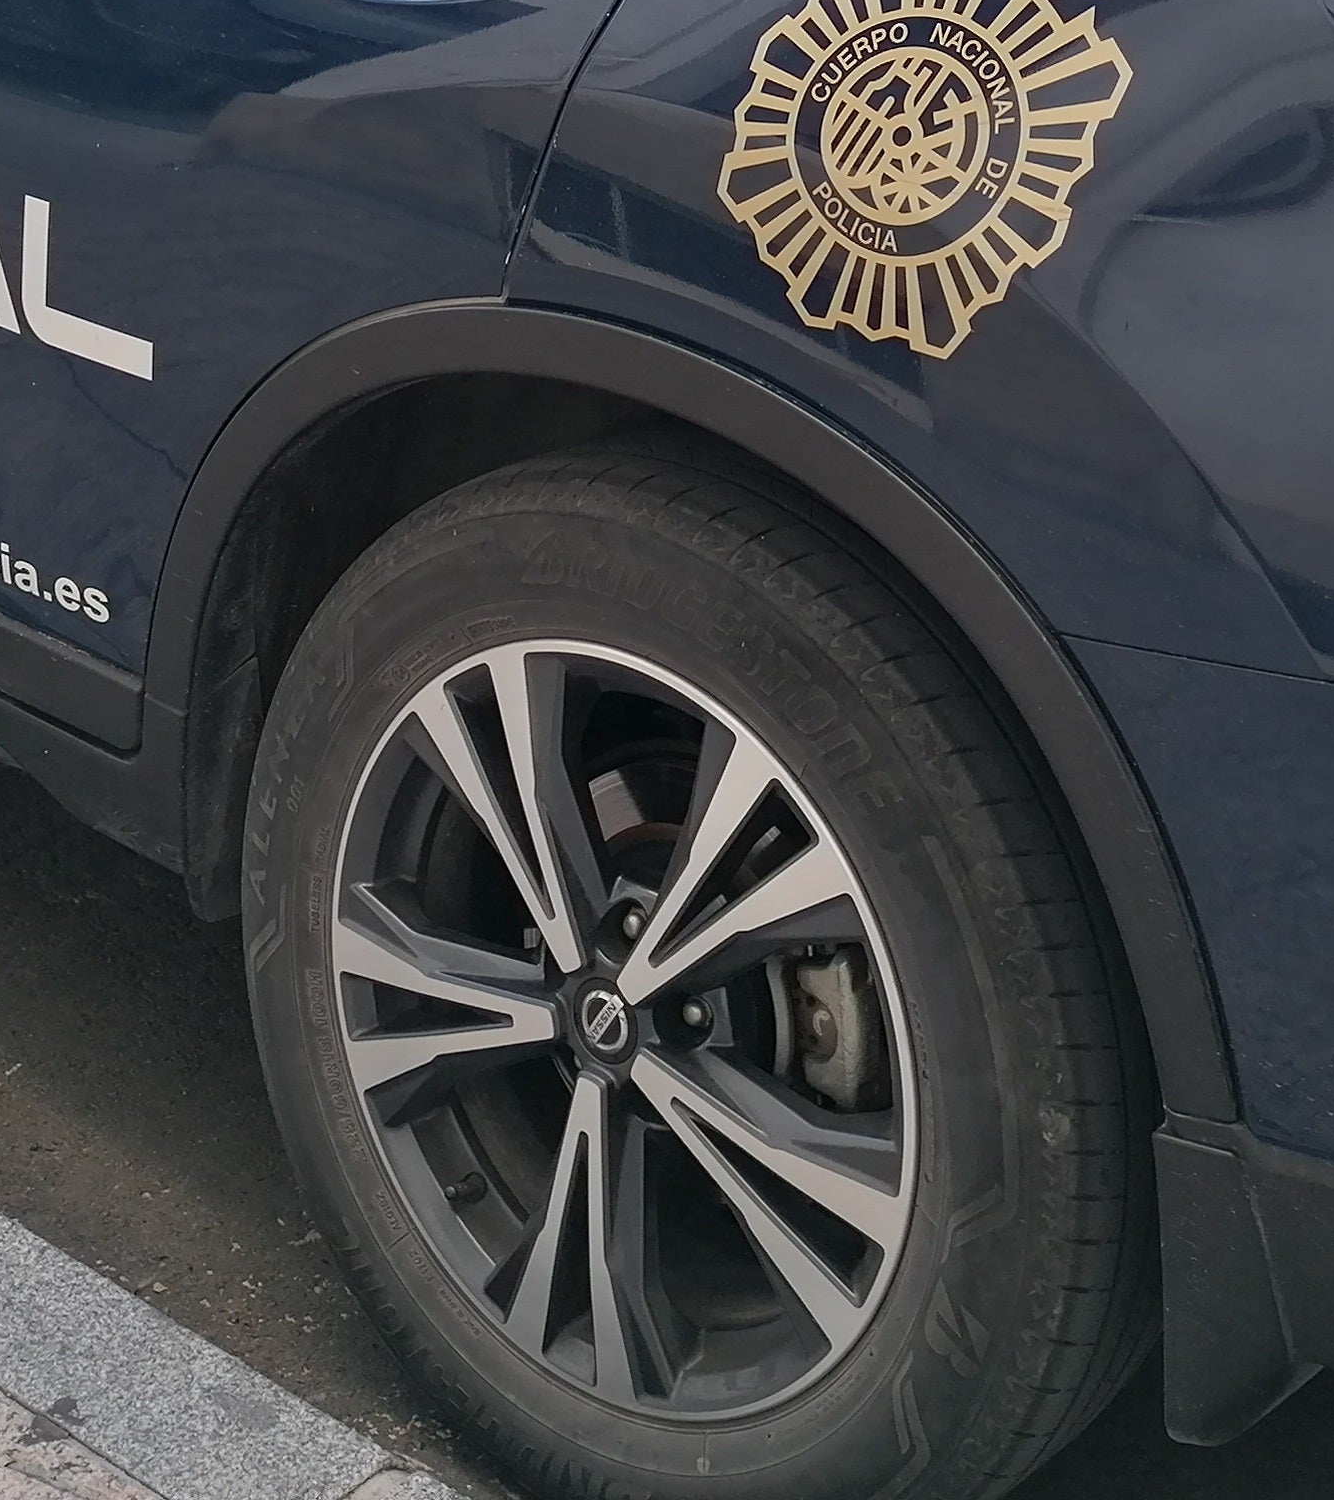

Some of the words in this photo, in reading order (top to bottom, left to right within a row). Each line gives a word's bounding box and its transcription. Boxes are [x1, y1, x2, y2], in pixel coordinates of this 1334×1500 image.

[811, 22, 909, 103] CUERPO
[929, 22, 1017, 136] NACIONAL
[973, 156, 1009, 200] DE
[811, 182, 899, 253] POLICIA
[522, 528, 905, 808] BRIDGESTONE
[587, 1002, 618, 1040] NISSAN
